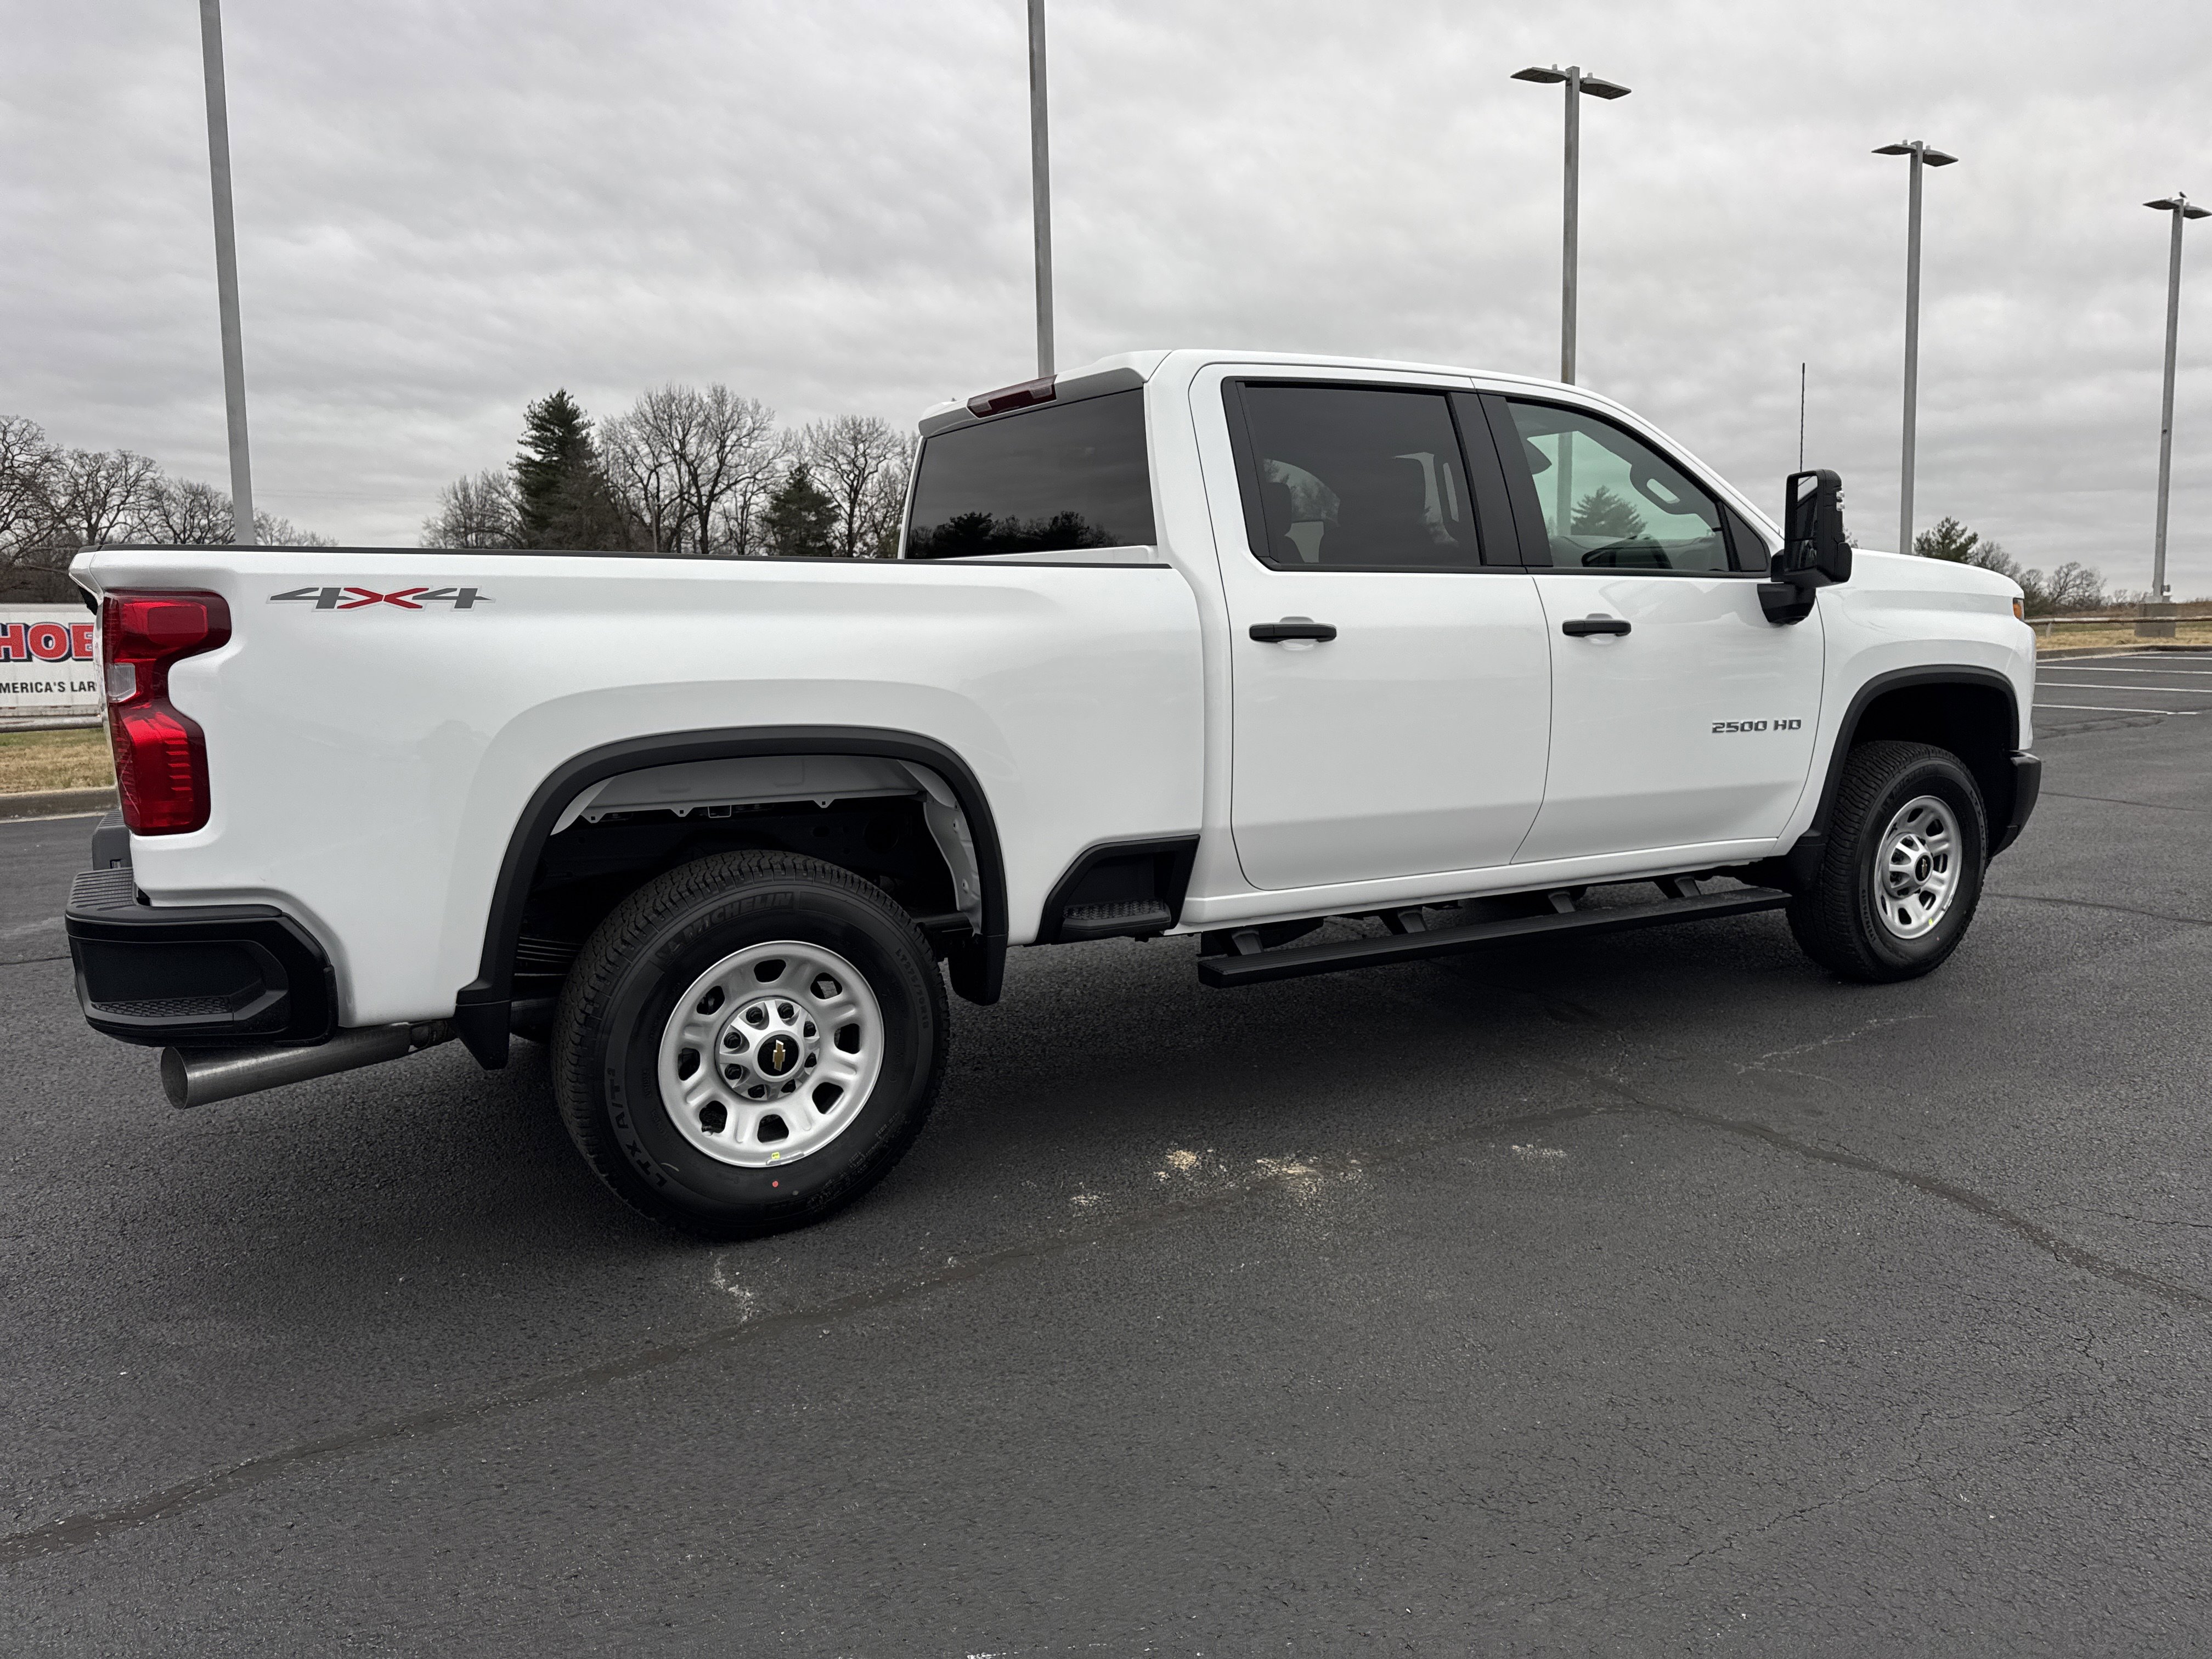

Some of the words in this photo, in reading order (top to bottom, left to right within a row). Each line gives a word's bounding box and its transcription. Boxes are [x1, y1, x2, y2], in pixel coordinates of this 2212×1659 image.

[269, 587, 493, 609] 4X4
[0, 681, 66, 693] MERICA'S
[1712, 721, 1768, 733] 2500
[1773, 719, 1802, 731] HD
[682, 891, 793, 939] MICHELIN
[625, 1139, 668, 1188] LTX
